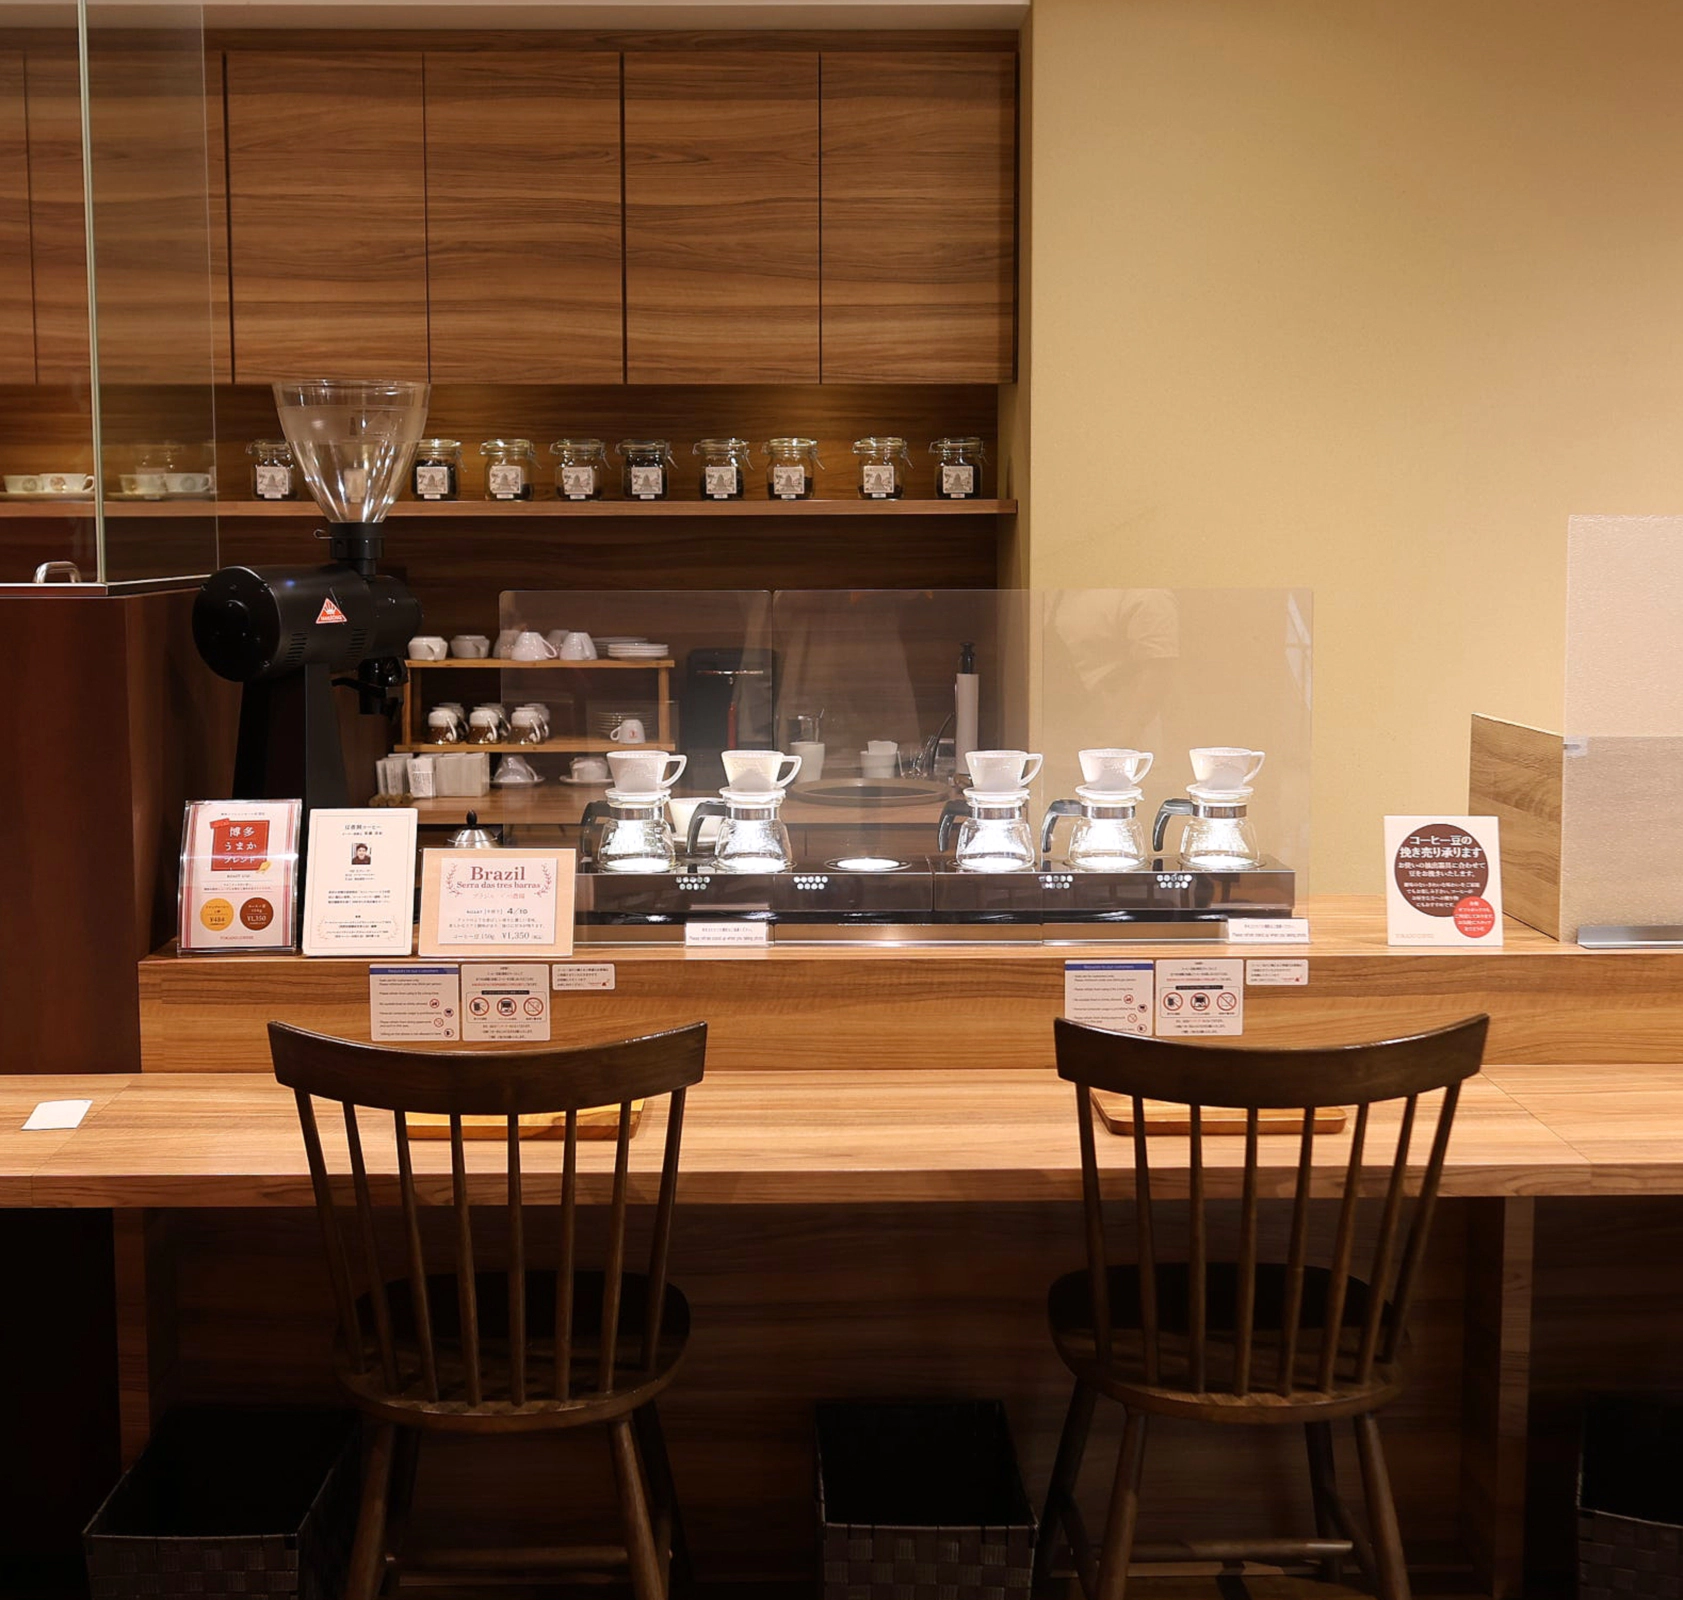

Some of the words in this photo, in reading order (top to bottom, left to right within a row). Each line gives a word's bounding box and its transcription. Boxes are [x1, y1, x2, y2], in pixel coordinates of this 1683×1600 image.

[229, 826, 255, 838] 博多
[225, 841, 257, 851] うまか
[1409, 834, 1473, 846] コーヒー豆の
[1399, 846, 1482, 858] 挽き売り承ります
[470, 866, 525, 881] Brazil
[456, 881, 479, 889] Serra
[481, 881, 495, 889] das
[514, 881, 541, 889] barras
[502, 932, 530, 940] ¥1,350
